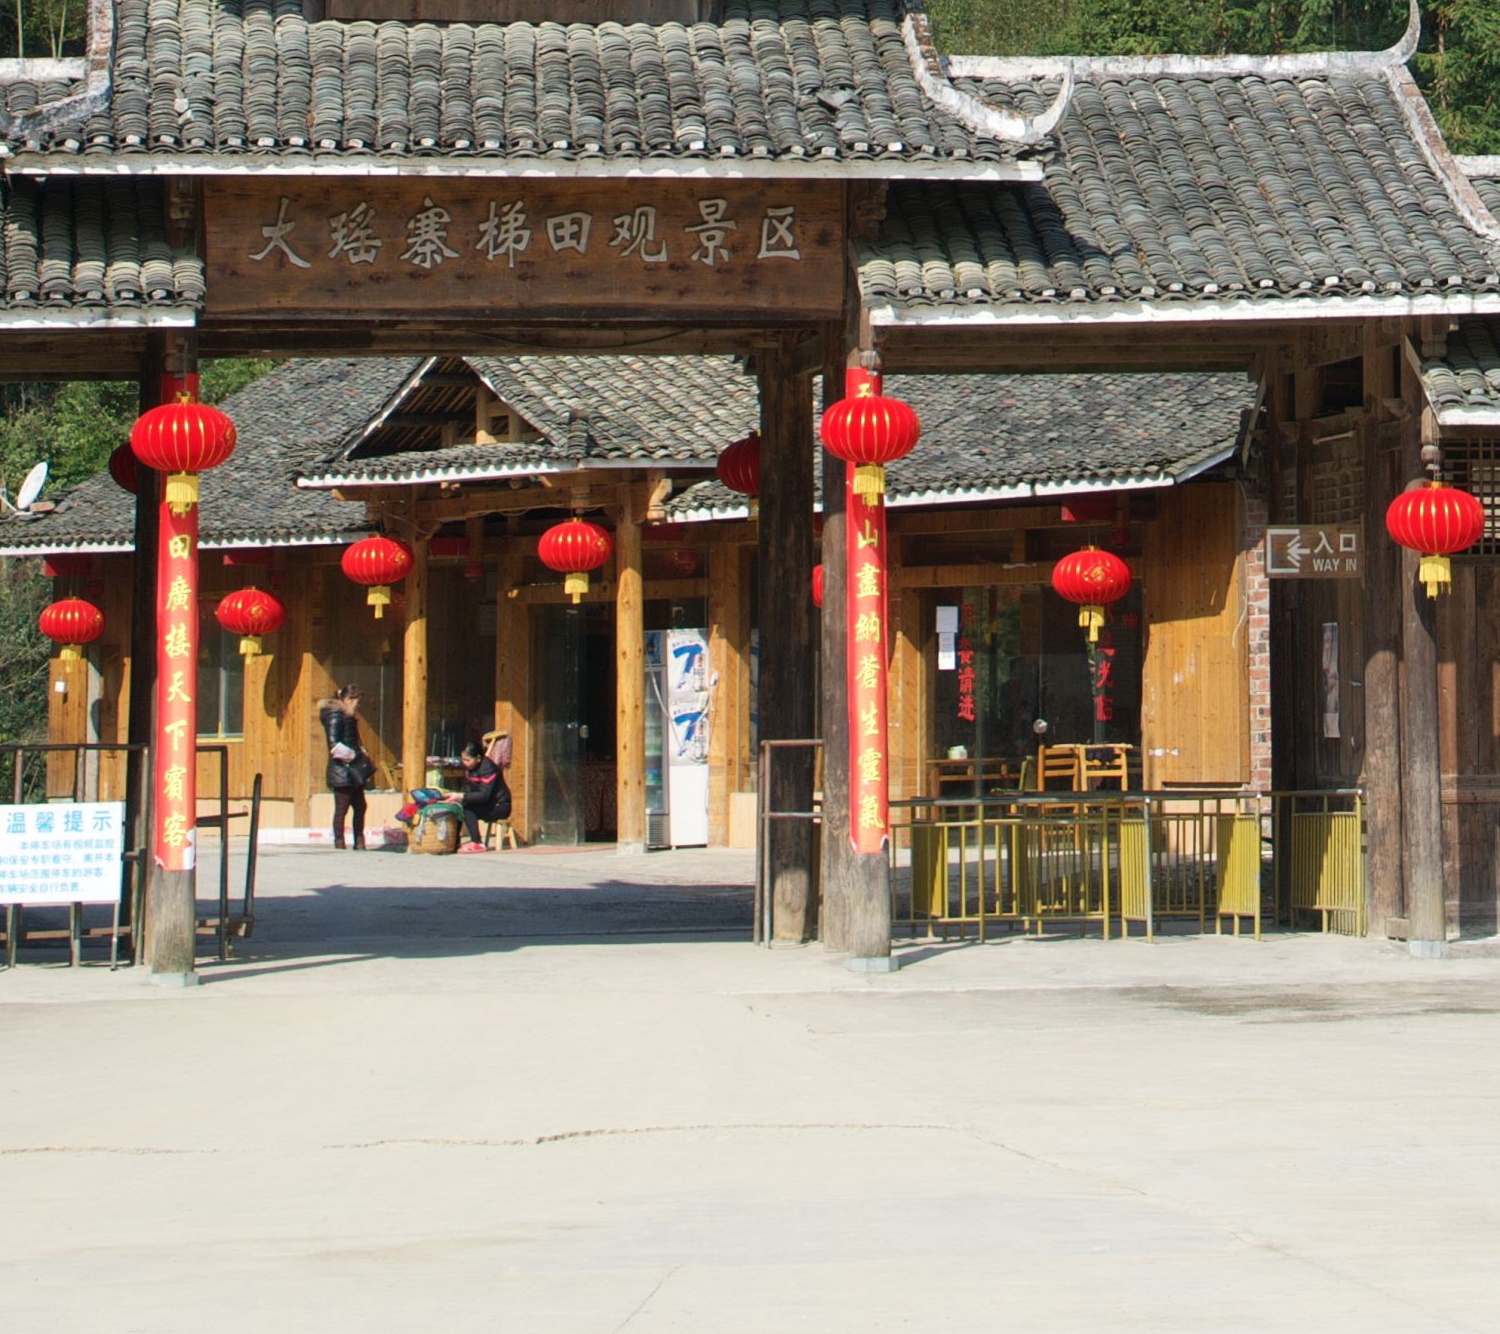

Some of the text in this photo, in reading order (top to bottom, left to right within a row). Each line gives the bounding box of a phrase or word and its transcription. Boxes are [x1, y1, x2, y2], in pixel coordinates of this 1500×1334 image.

[248, 196, 802, 269] 大瑶寨梯田观景区
[1314, 531, 1356, 554] 入口
[1313, 558, 1357, 572] WAY IN
[6, 810, 113, 834] 温馨提示
